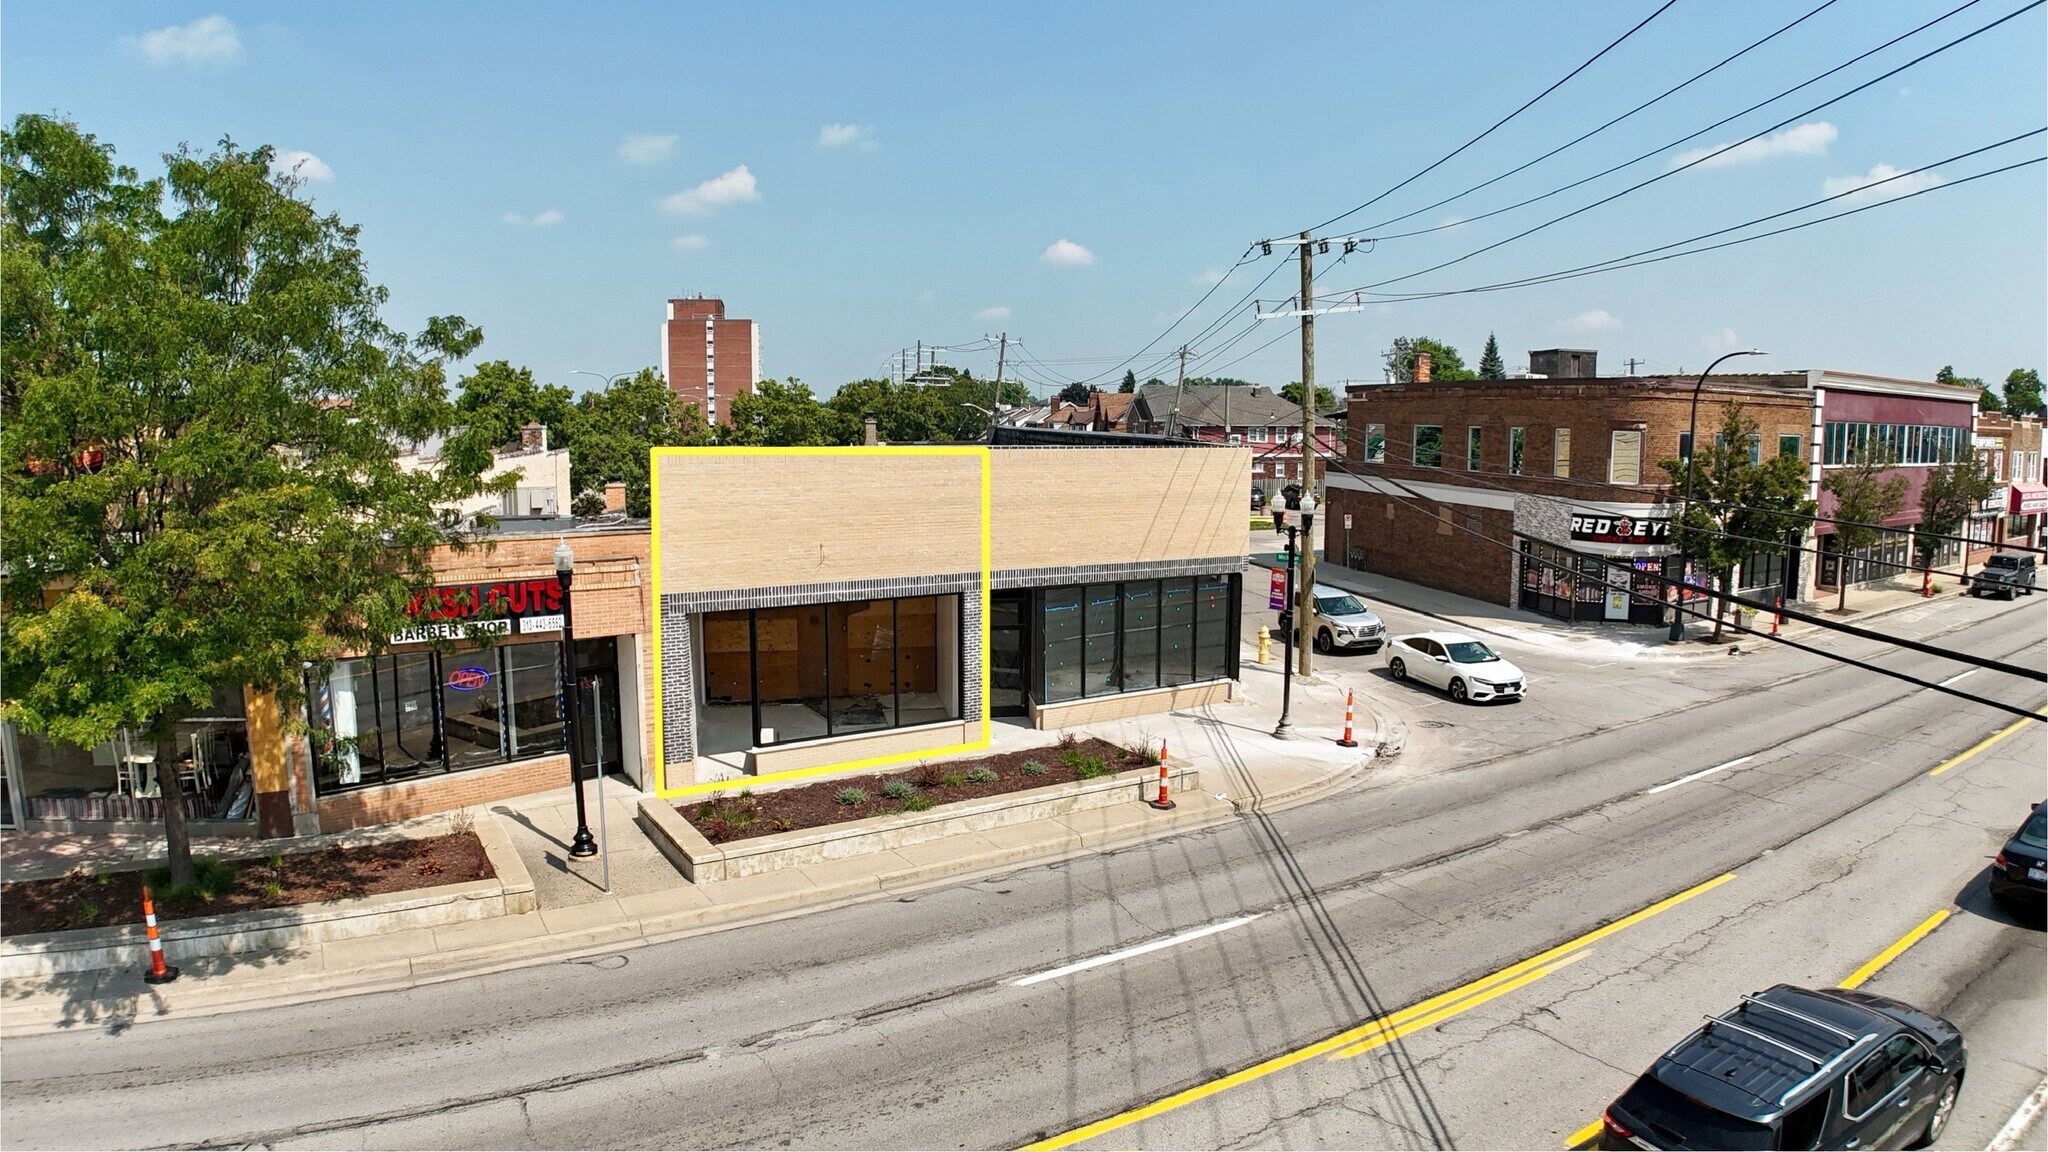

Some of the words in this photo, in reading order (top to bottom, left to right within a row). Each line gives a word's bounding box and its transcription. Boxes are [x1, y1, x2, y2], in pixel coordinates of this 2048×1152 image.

[1570, 517, 1611, 534] RED
[1635, 562, 1659, 571] OPEN
[393, 623, 459, 642] BARBER
[449, 670, 486, 689] OPEN
